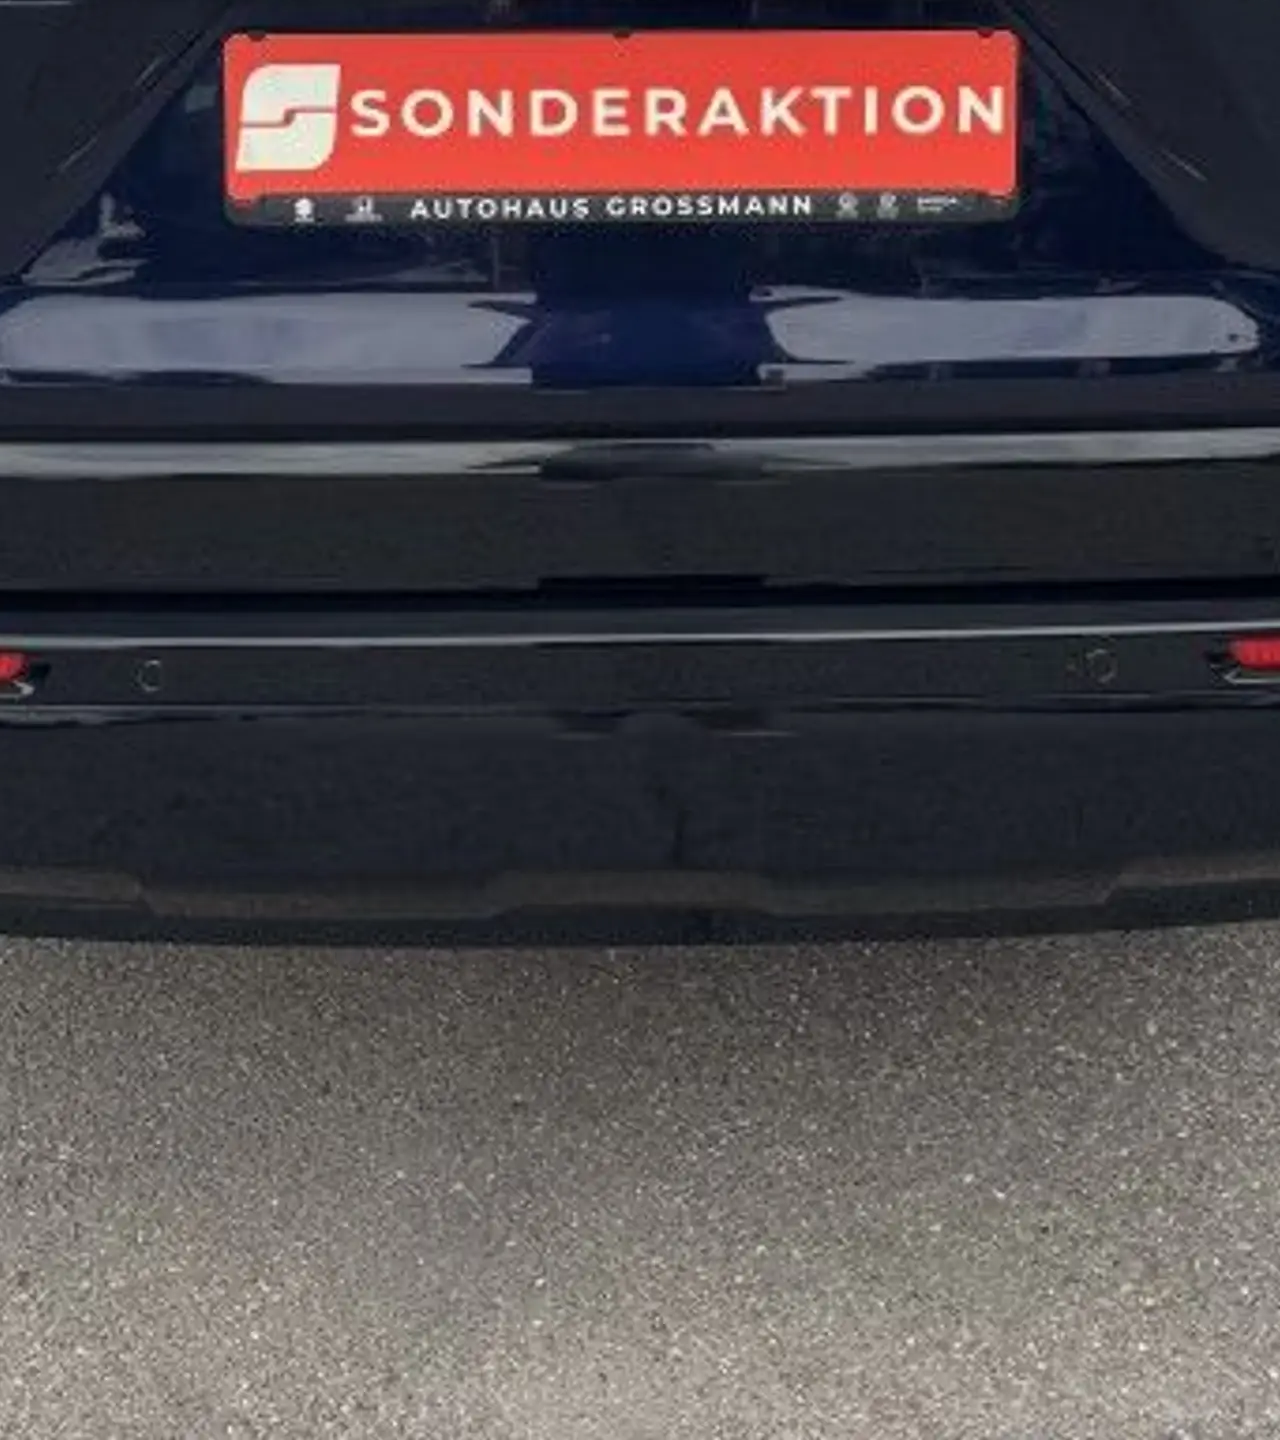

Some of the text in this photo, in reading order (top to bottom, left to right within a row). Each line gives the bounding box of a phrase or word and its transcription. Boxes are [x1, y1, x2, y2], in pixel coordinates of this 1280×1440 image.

[351, 84, 1006, 138] SONDERAKTION
[410, 195, 813, 221] AUTOHAUS GROSSMANN
